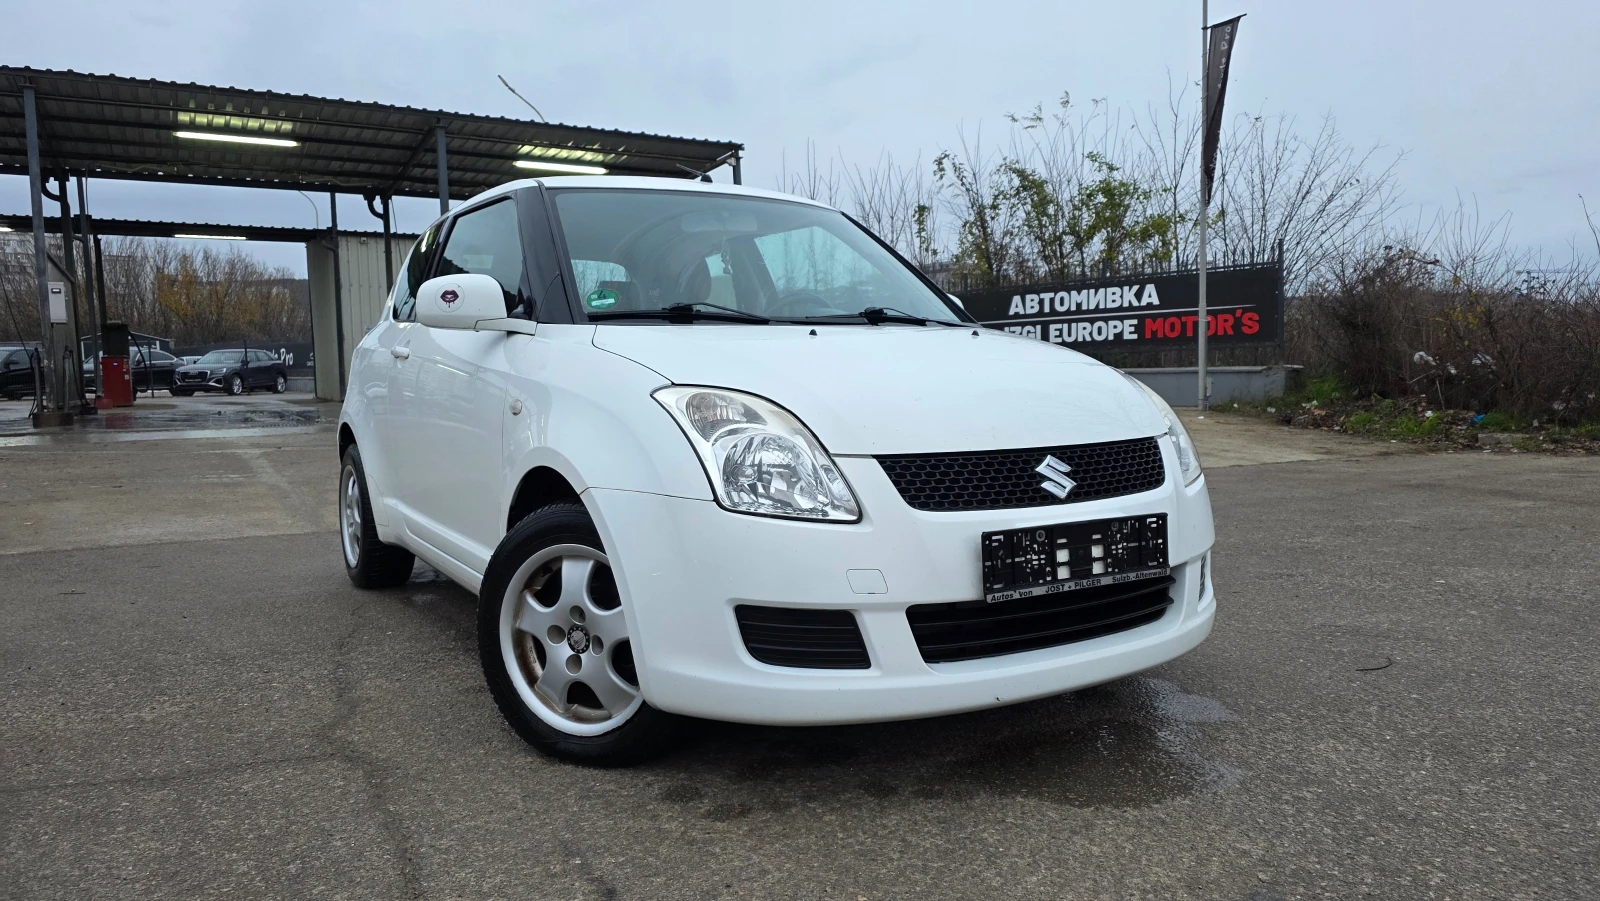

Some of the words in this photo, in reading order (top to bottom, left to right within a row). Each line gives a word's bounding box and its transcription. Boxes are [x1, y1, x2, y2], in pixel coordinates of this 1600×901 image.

[1008, 283, 1160, 316] АВТОМИВКА
[1049, 319, 1138, 343] EUROPE
[990, 593, 1014, 603] Autos
[1045, 583, 1066, 594] JOST
[1074, 578, 1102, 589] PILGER
